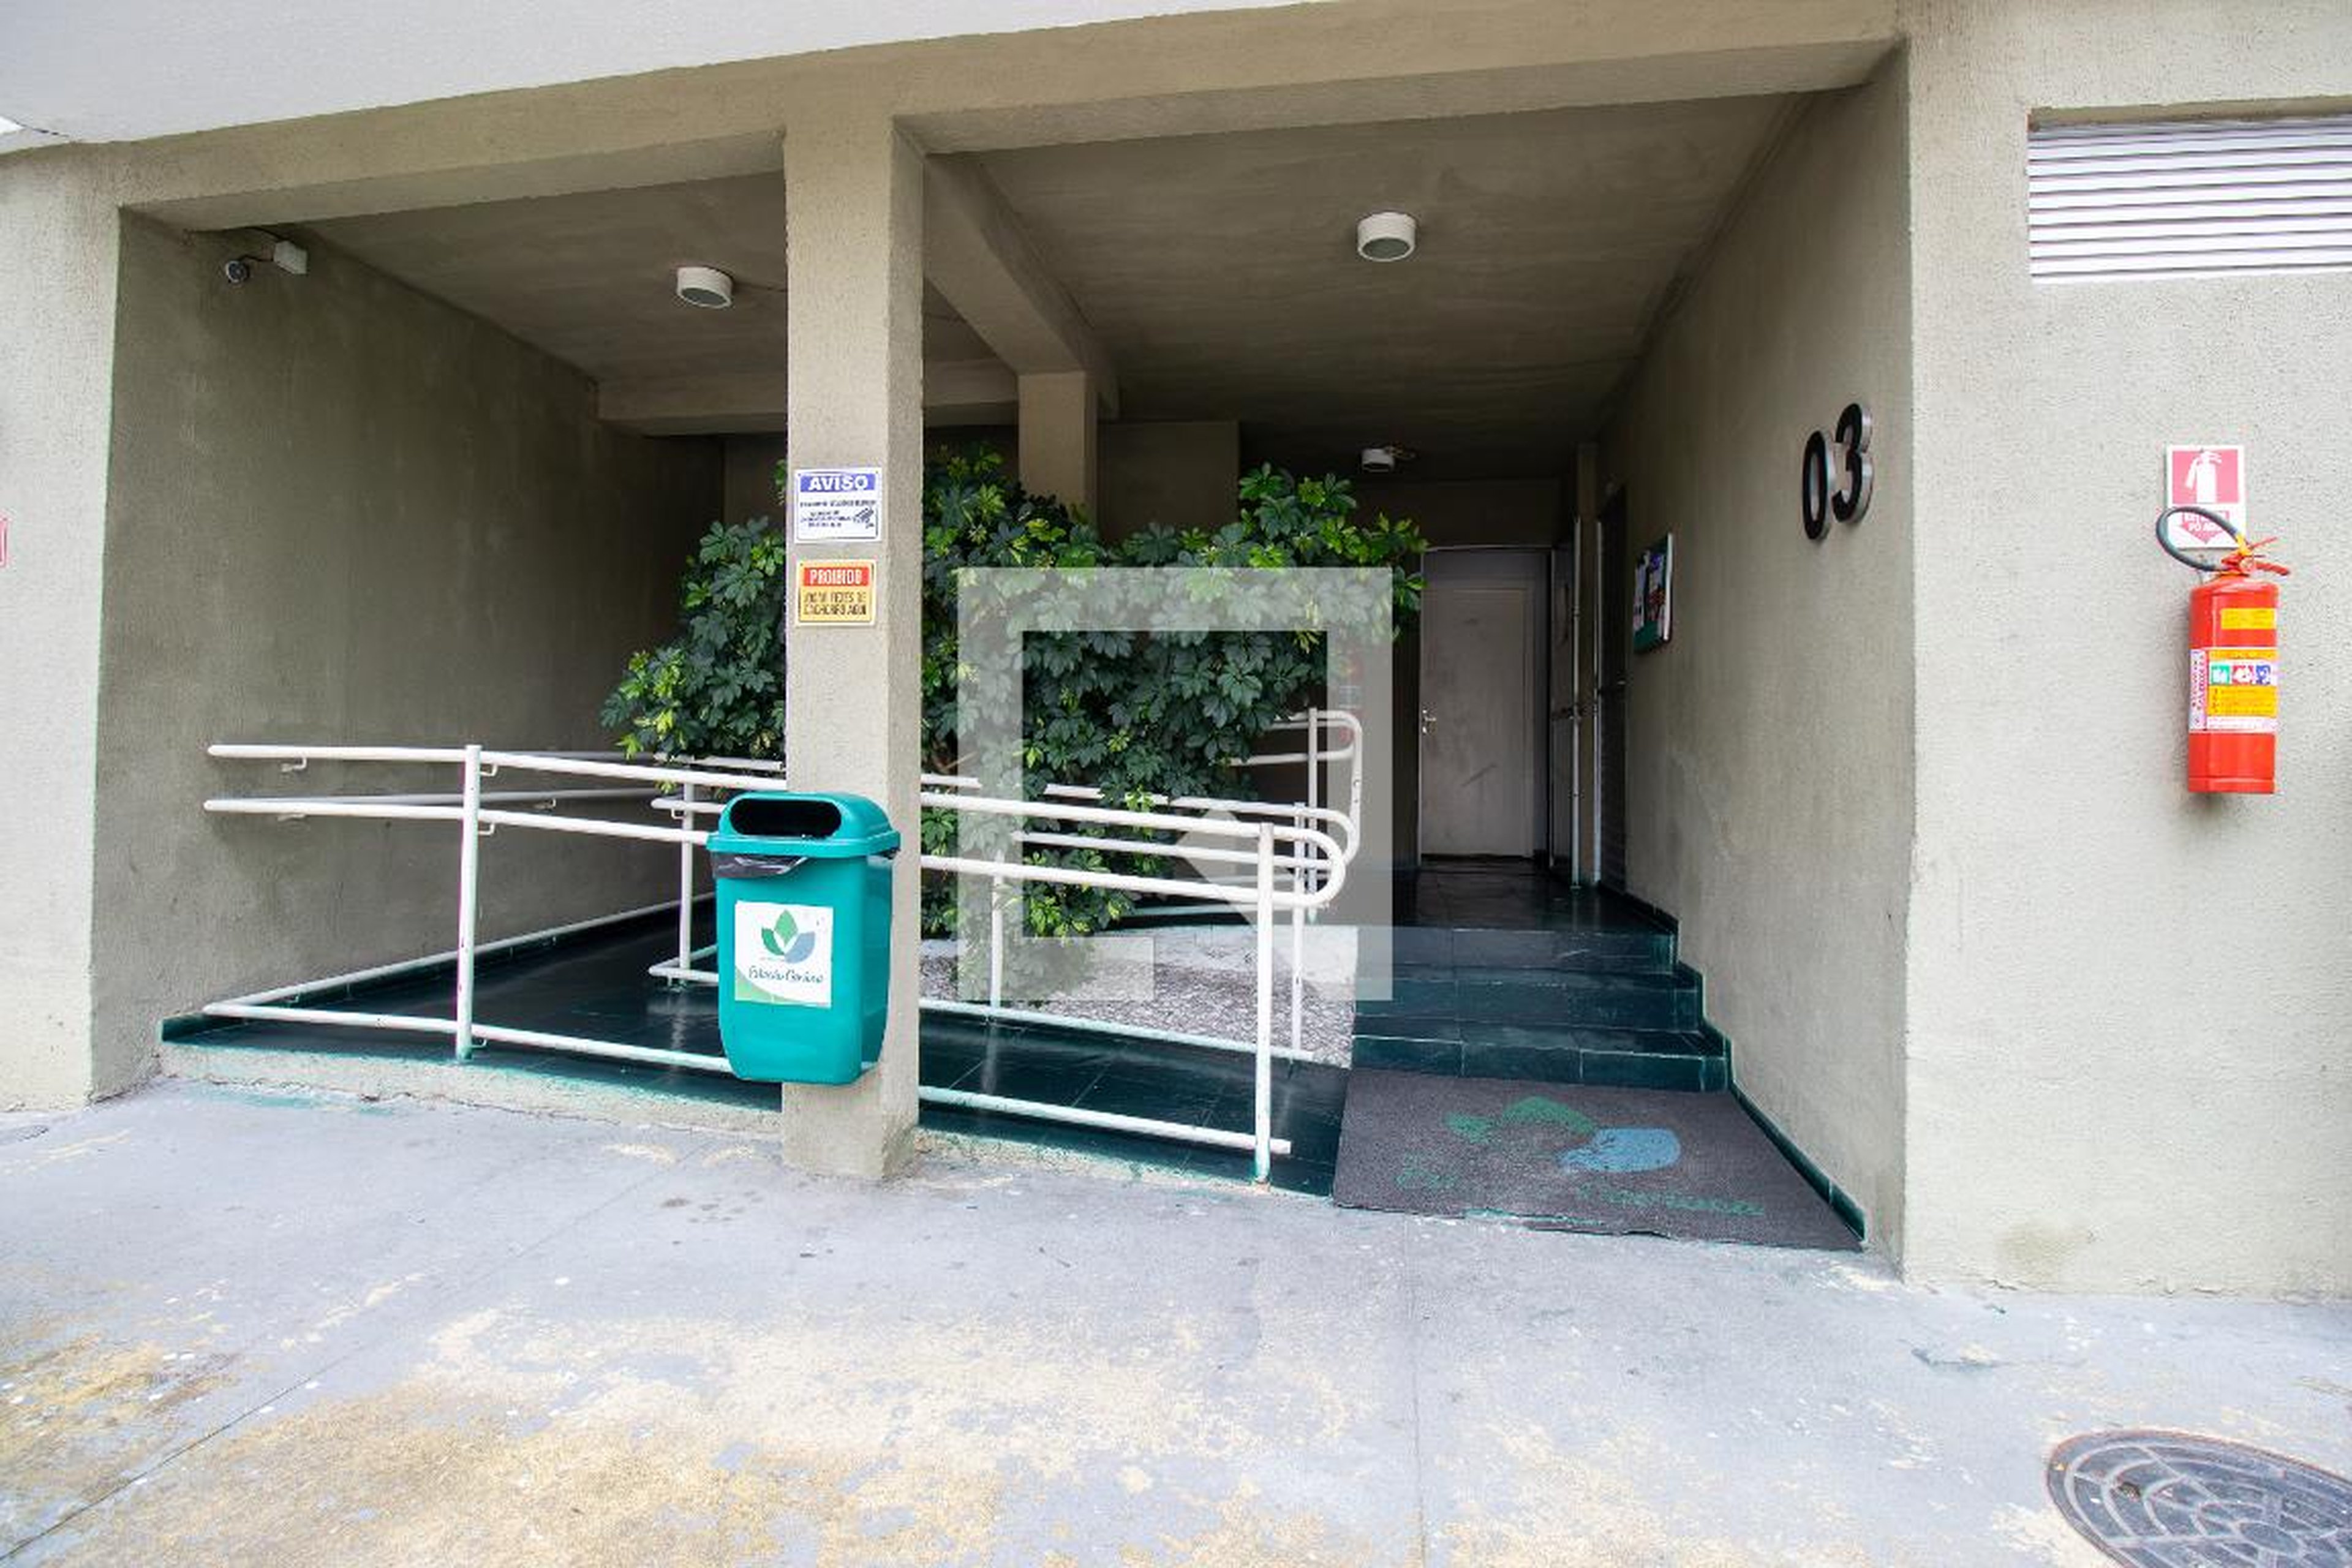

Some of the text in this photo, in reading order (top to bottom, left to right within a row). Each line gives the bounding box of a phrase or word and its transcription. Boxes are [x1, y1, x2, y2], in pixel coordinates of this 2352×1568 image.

[1803, 402, 1873, 541] 03
[808, 475, 869, 491] AVISO
[810, 568, 862, 585] PROIBIDO
